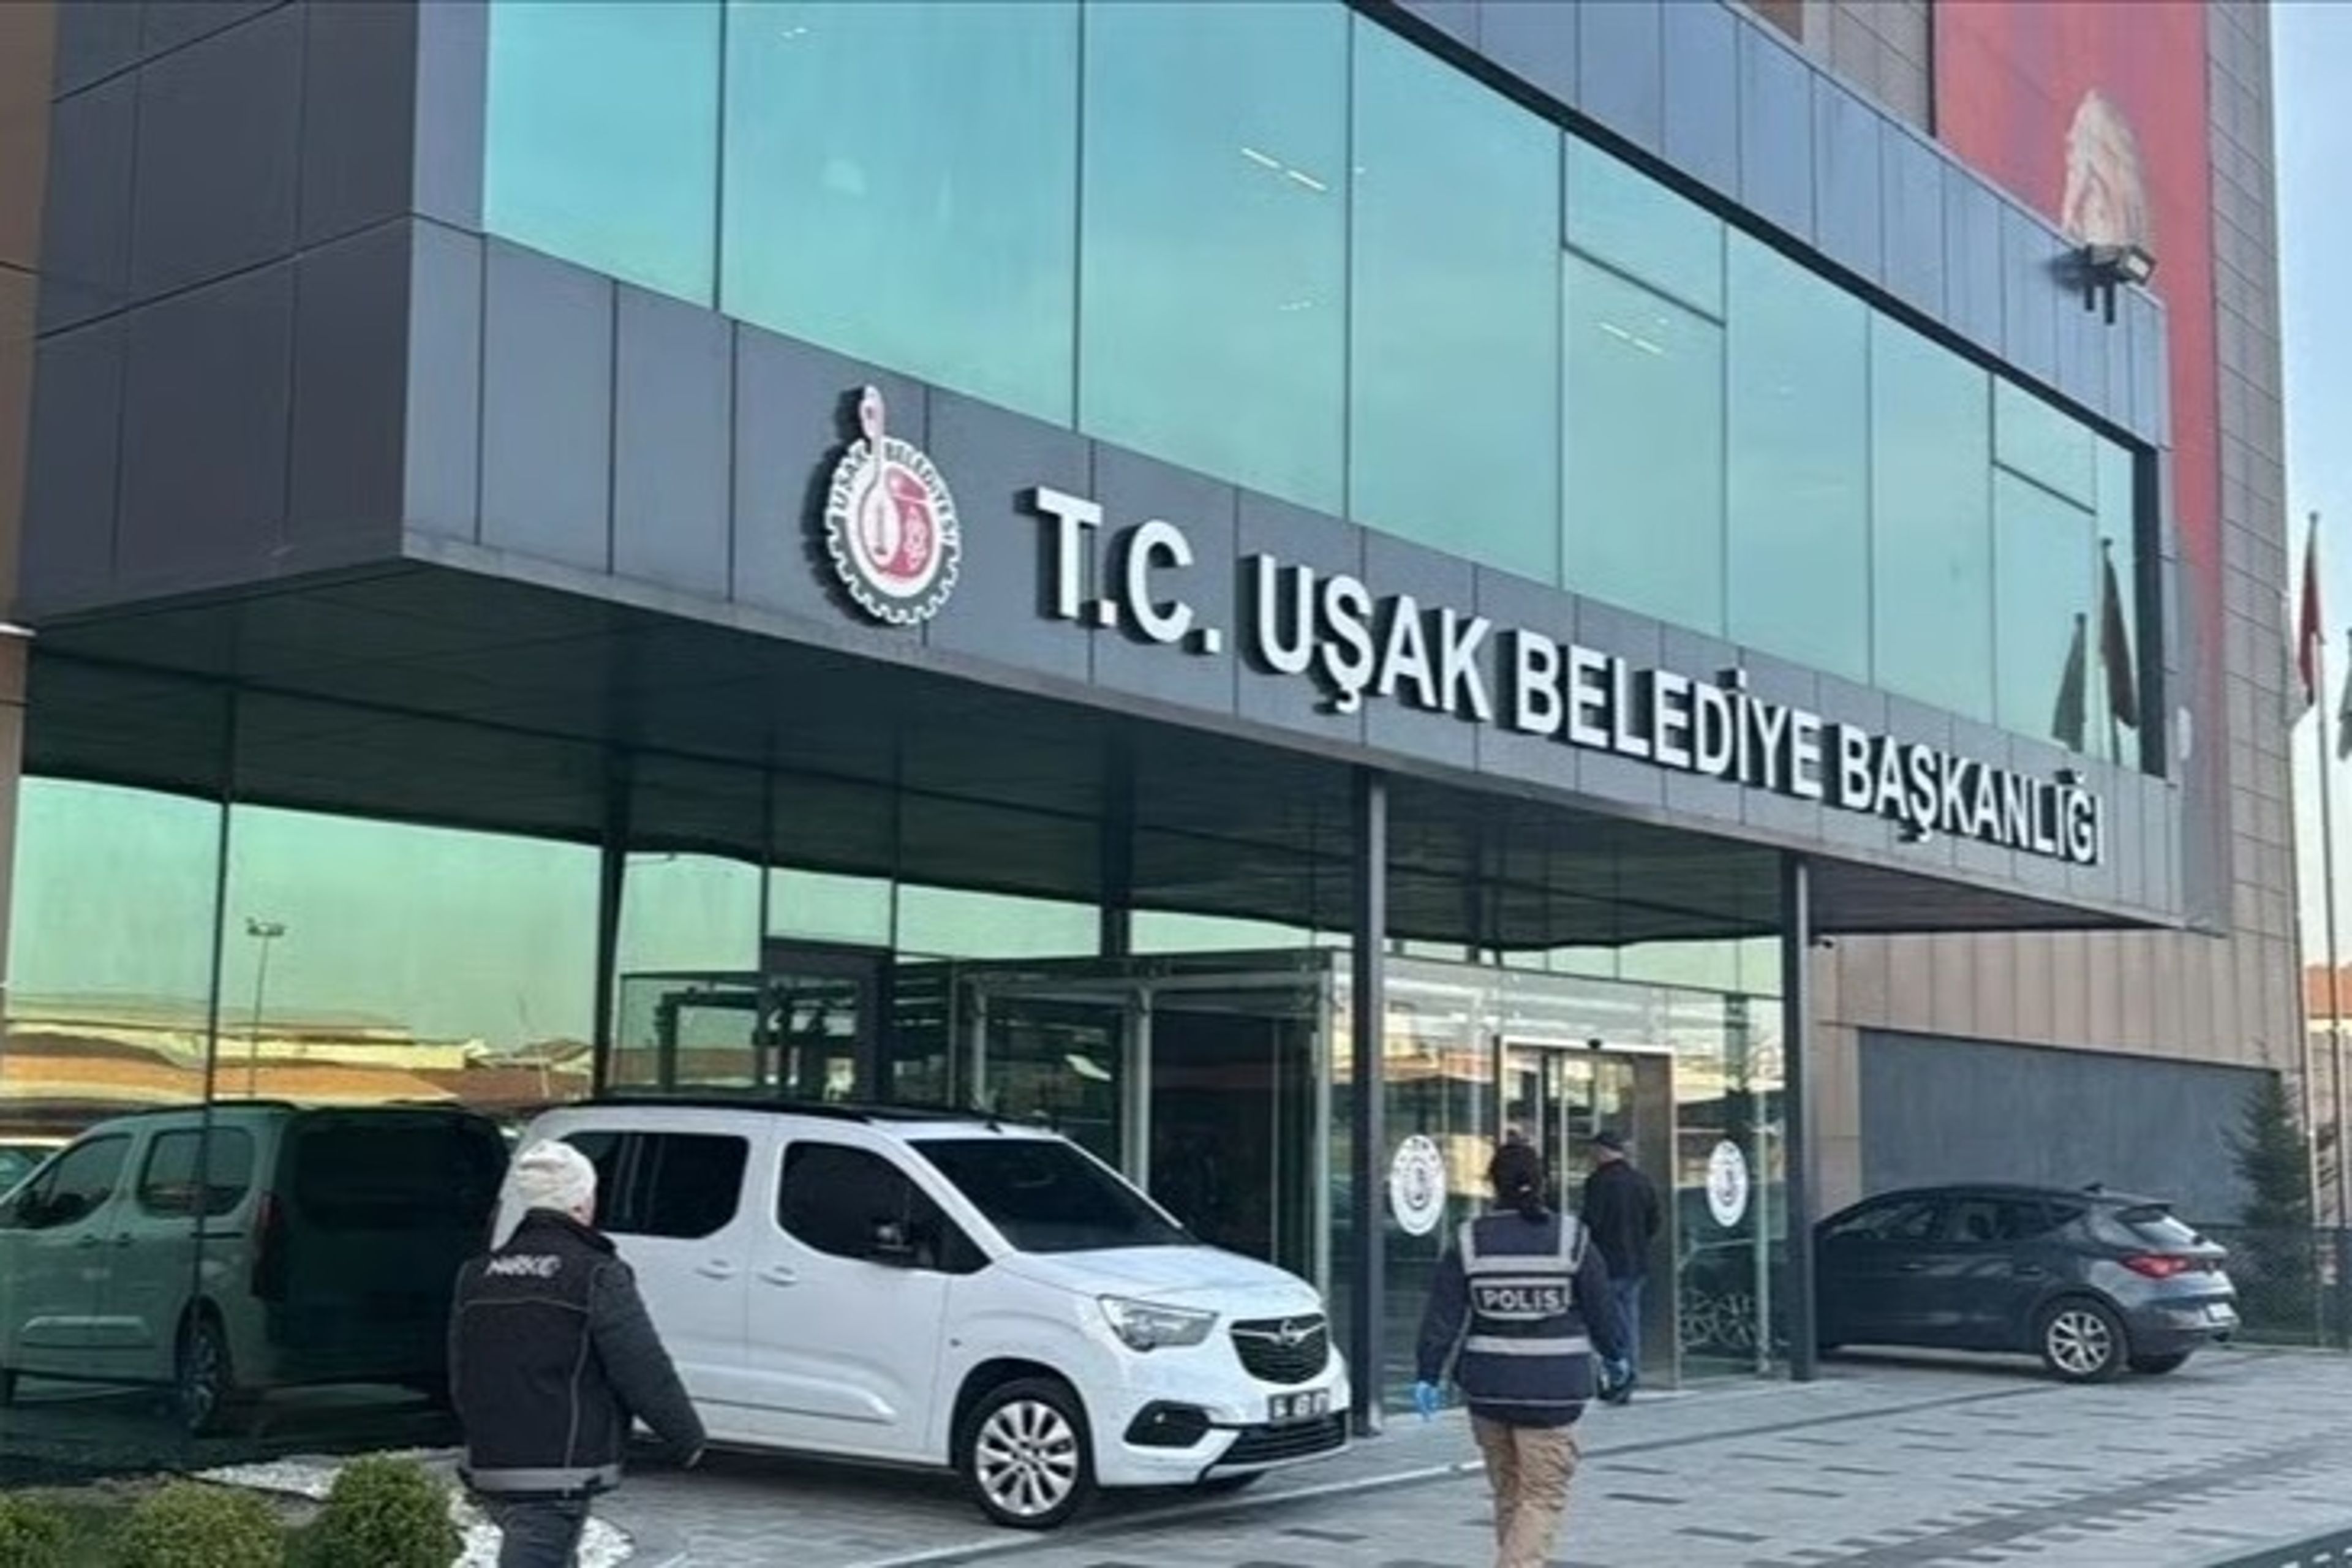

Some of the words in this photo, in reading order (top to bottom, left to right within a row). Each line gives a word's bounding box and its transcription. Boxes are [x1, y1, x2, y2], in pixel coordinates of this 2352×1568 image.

[1036, 486, 1221, 654] T.C.
[1258, 553, 1492, 722] UŞAK
[1515, 627, 1824, 799] BELEDİYE
[1841, 723, 2105, 866] BAŞKANLIĞI
